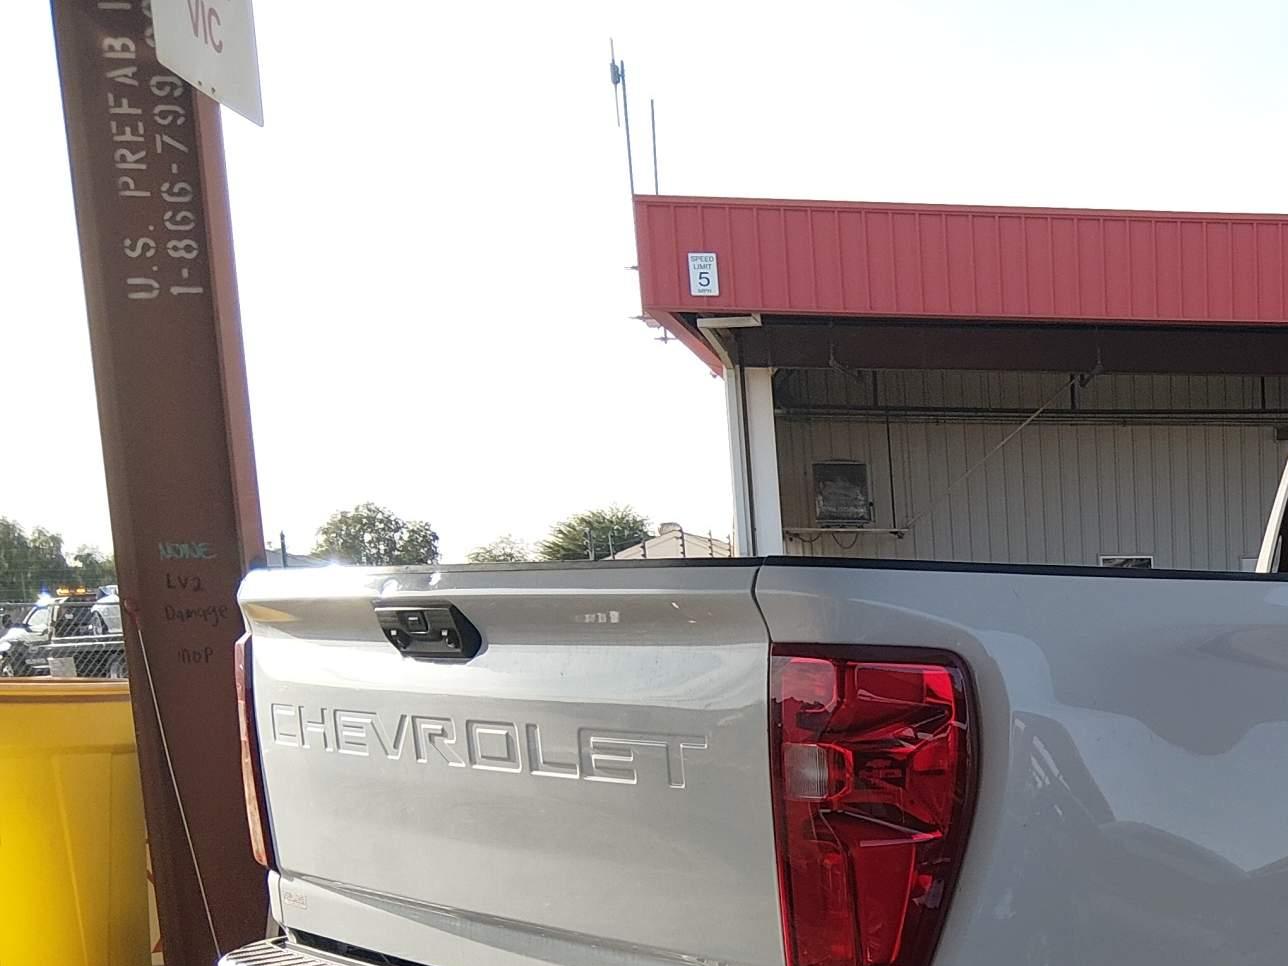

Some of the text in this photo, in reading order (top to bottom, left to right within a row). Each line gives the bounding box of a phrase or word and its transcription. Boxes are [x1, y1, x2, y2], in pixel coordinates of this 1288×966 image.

[102, 36, 151, 198] PREFAB
[123, 225, 160, 299] U.S.
[698, 272, 711, 287] 5
[270, 701, 709, 790] CHEVROLET
